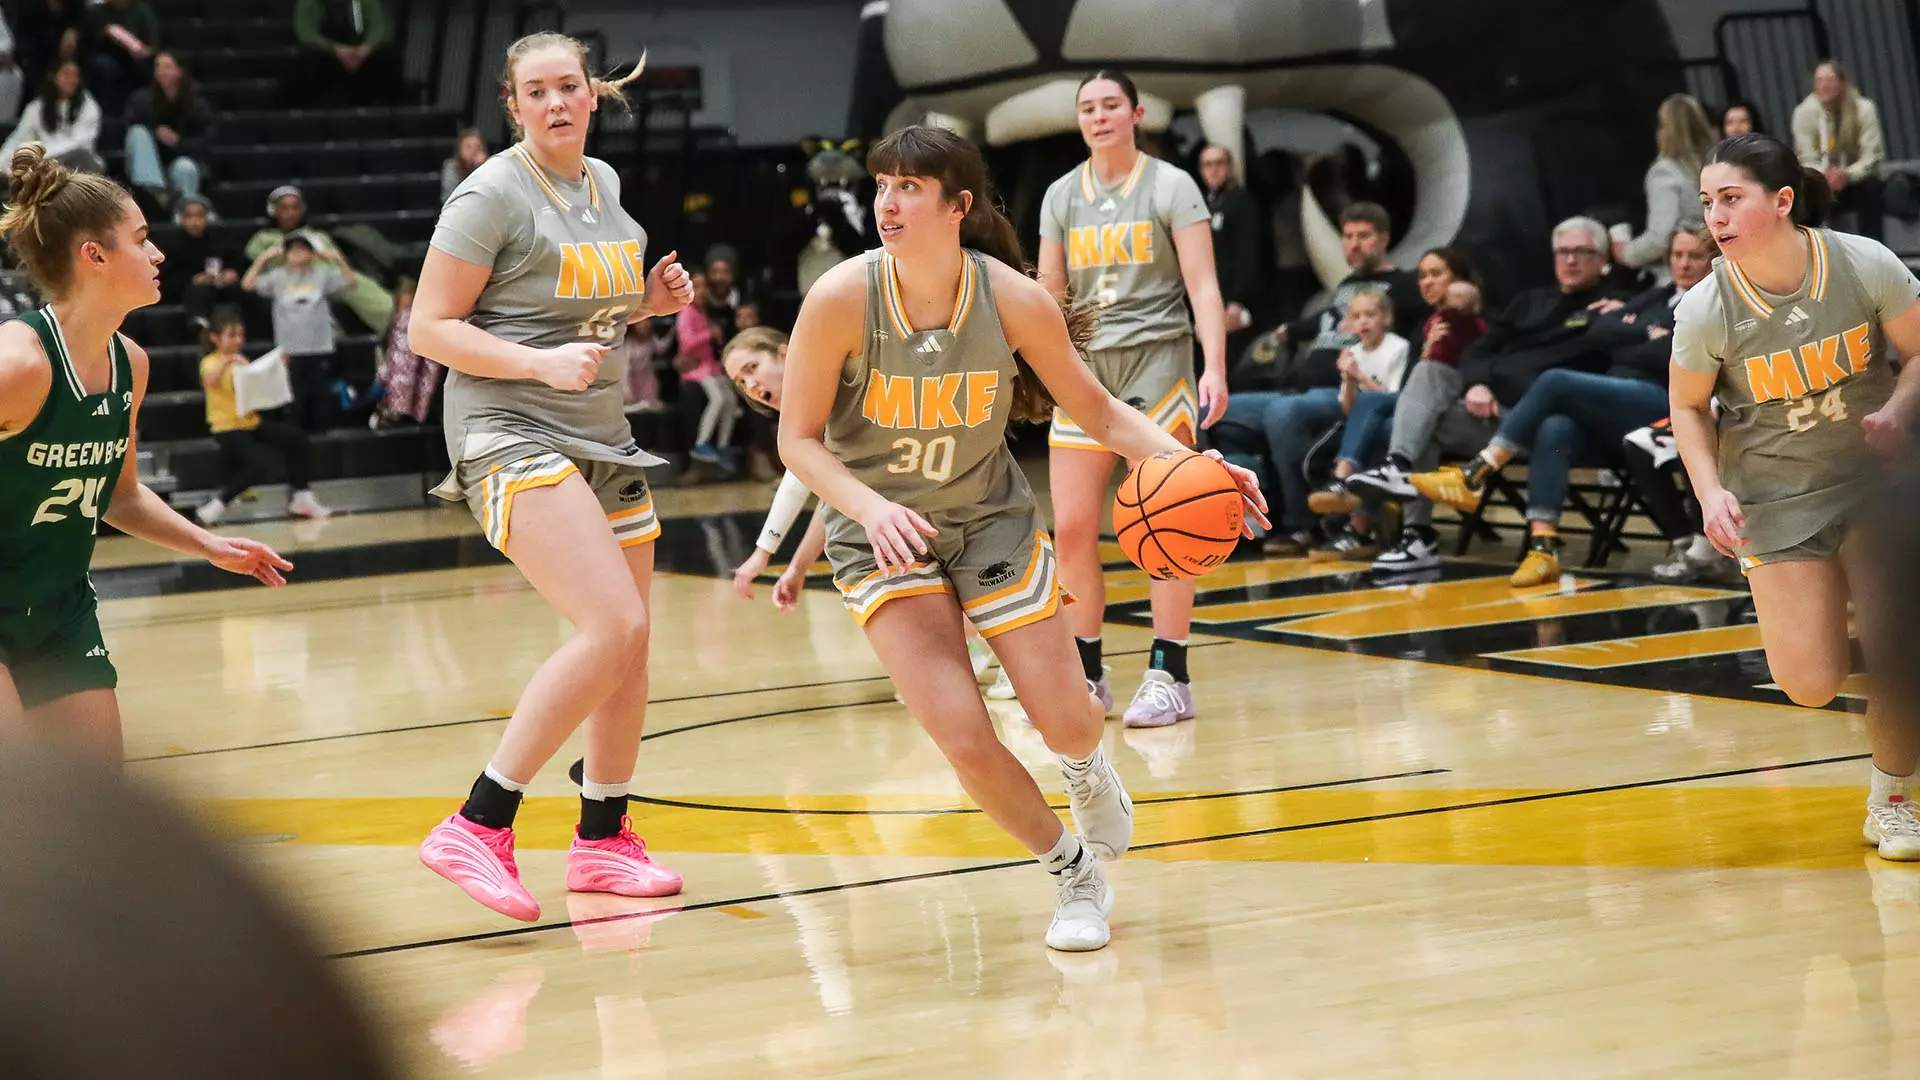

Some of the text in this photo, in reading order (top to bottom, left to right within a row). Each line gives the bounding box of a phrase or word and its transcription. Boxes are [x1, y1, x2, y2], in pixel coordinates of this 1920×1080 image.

[554, 239, 645, 299] MKE
[1069, 221, 1153, 270] MKE
[1097, 273, 1118, 307] 5
[1744, 322, 1871, 403] MKE
[862, 368, 999, 430] MKE
[1783, 387, 1848, 432] 24
[26, 437, 129, 468] GREEN BY
[887, 435, 956, 482] 30
[30, 476, 107, 536] 24
[978, 568, 1016, 587] MILWAUKEE
